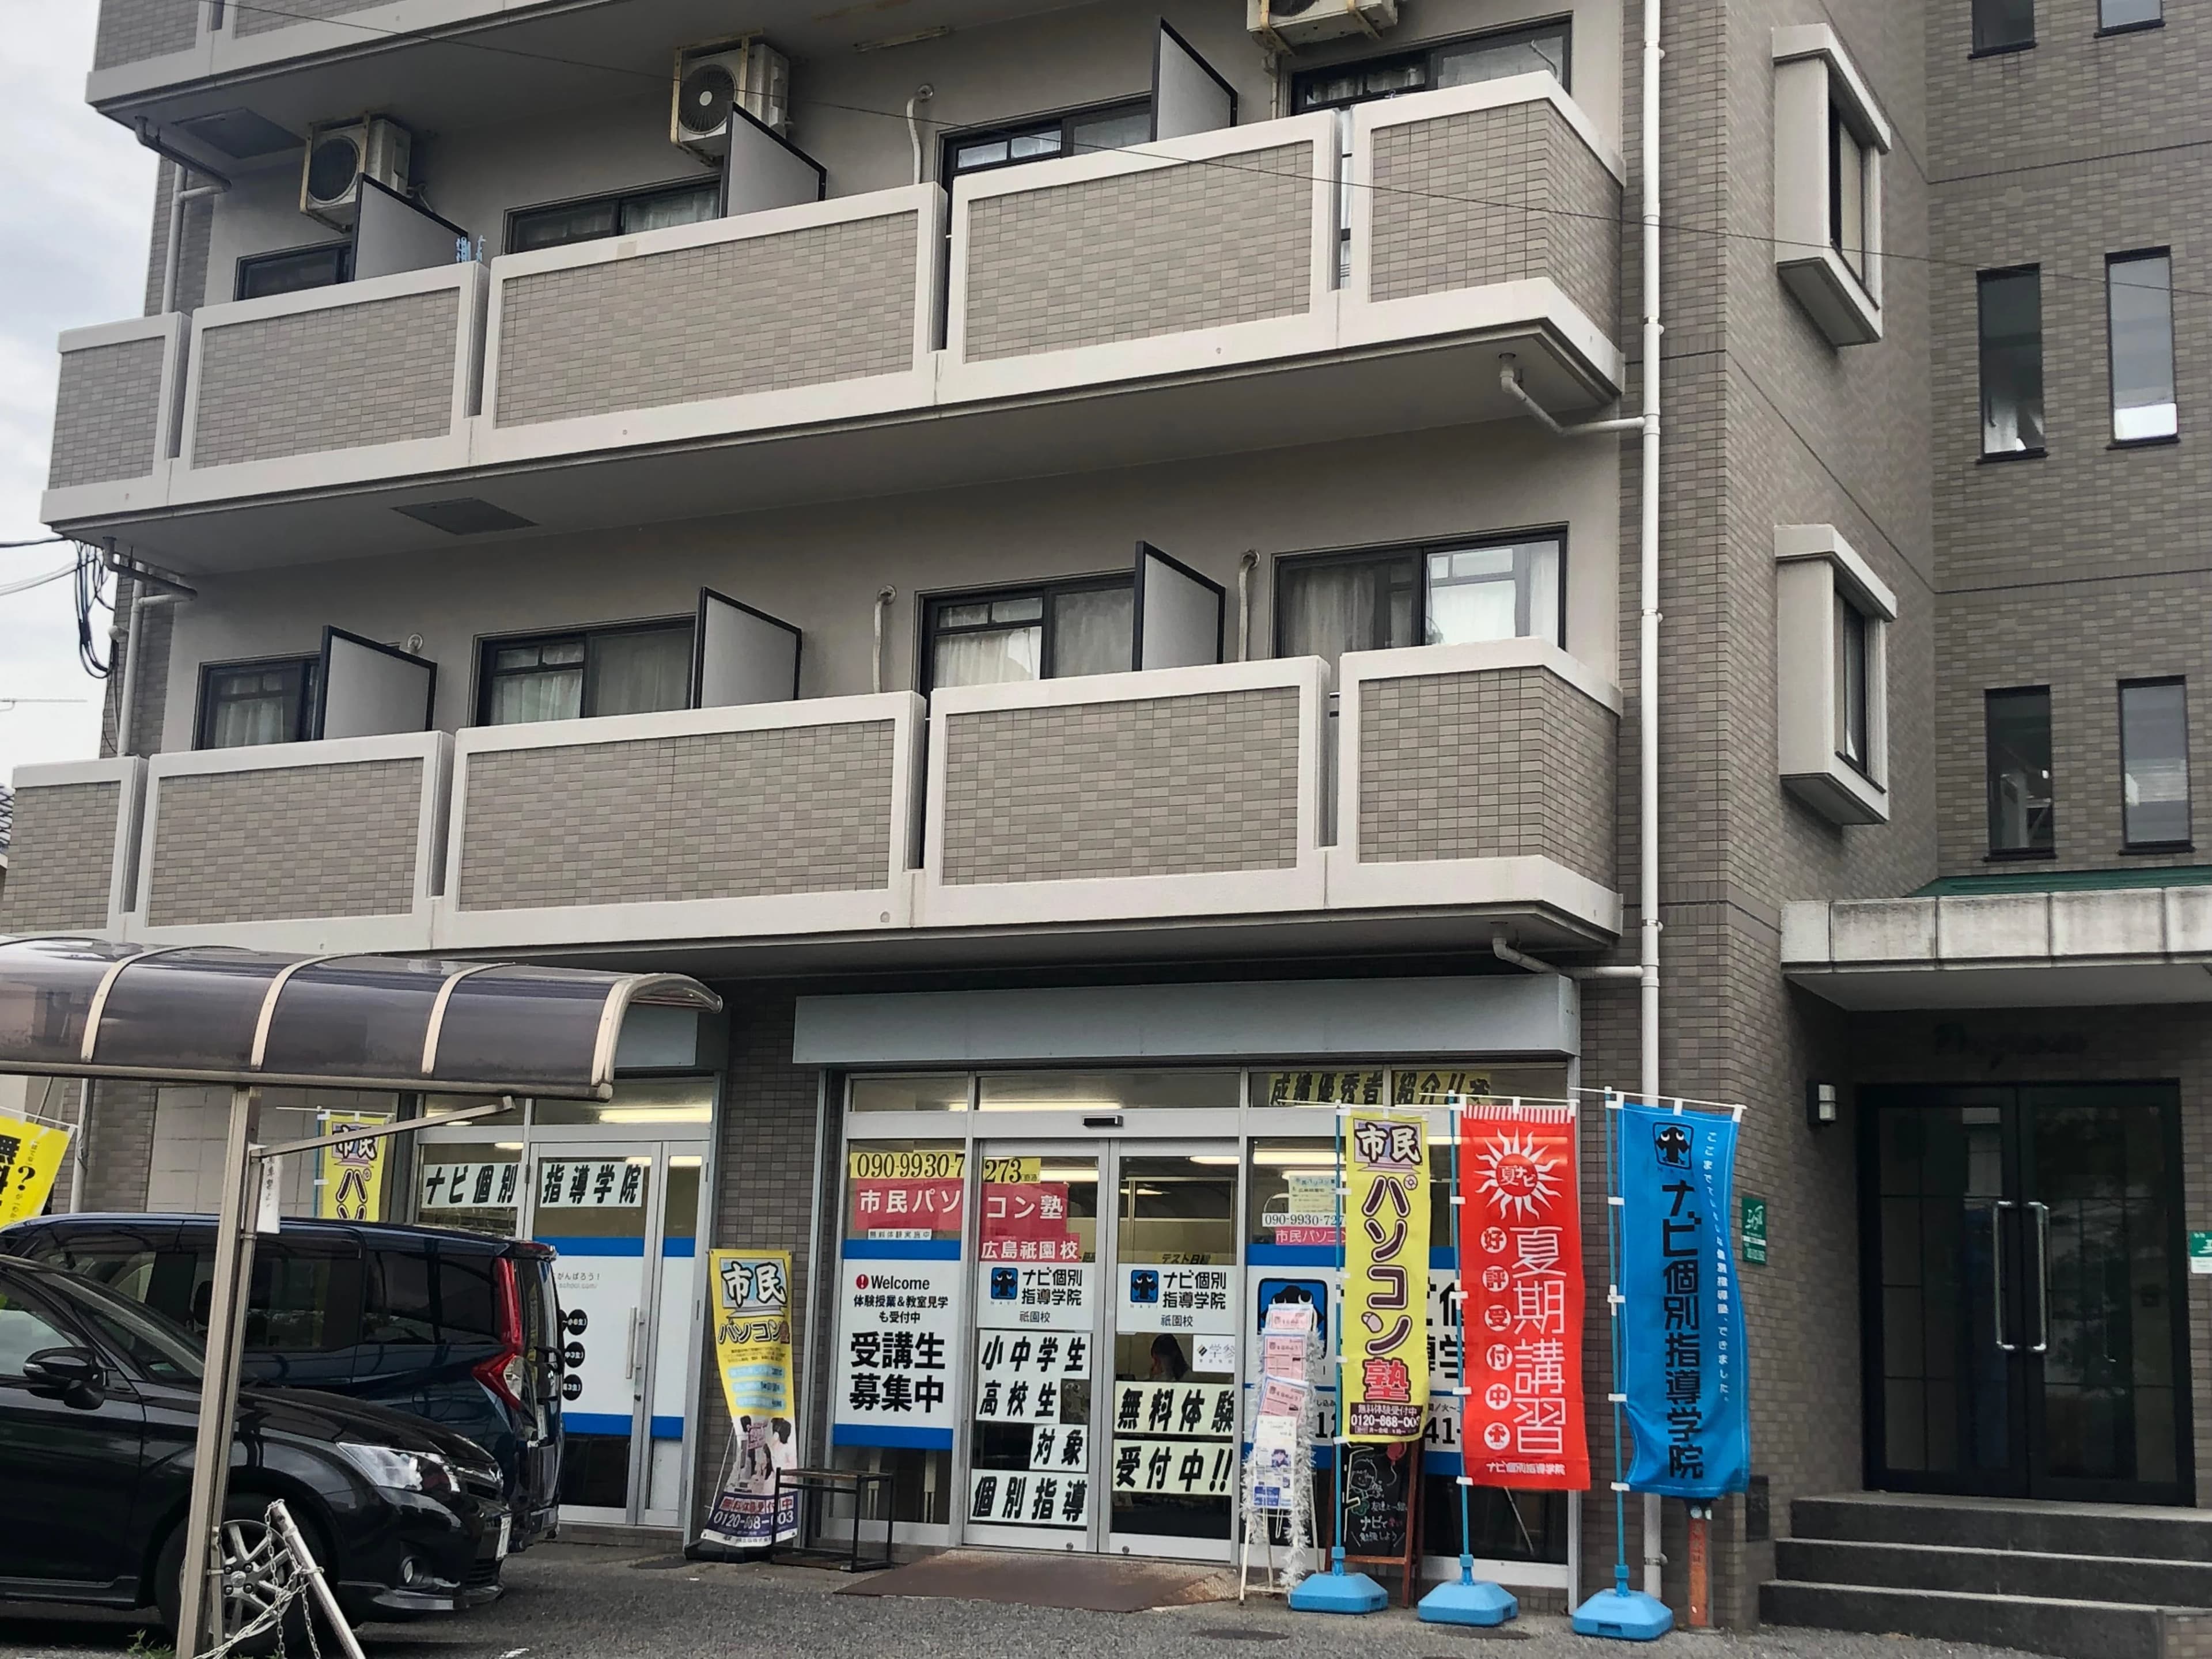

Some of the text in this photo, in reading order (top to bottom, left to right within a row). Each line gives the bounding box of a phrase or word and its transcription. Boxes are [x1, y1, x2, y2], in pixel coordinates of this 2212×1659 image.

[1354, 1122, 1423, 1165] 市民
[425, 1164, 642, 1205] ナビ個別 指導学院
[1498, 1165, 1536, 1187] 夏ナビ
[859, 1188, 1063, 1219] 市民パソ コン塾
[980, 1240, 1078, 1260] 広島祇園校
[721, 1261, 787, 1307] 市民
[870, 1275, 930, 1290] Welcome
[1022, 1267, 1082, 1286] ナビ個別
[1163, 1269, 1226, 1290] ナビ個別
[1361, 1175, 1418, 1404] パソコン塾
[1021, 1288, 1082, 1306] 指導学院
[1162, 1291, 1226, 1310] 指導学院
[879, 1311, 921, 1324] も受付中
[1481, 1227, 1512, 1409] 好評受付中
[1661, 1179, 1703, 1480] ナビ個別指導学院
[849, 1331, 946, 1370] 受講生
[981, 1335, 1086, 1373] 小中学生
[1509, 1226, 1567, 1454] 夏期講習
[849, 1373, 945, 1412] 募集中
[979, 1380, 1057, 1418] 高校生
[1117, 1387, 1234, 1433] 無料体験
[1033, 1428, 1084, 1465] 対象
[1115, 1445, 1233, 1492] 受付中!!
[972, 1475, 1088, 1522] 個別指導
